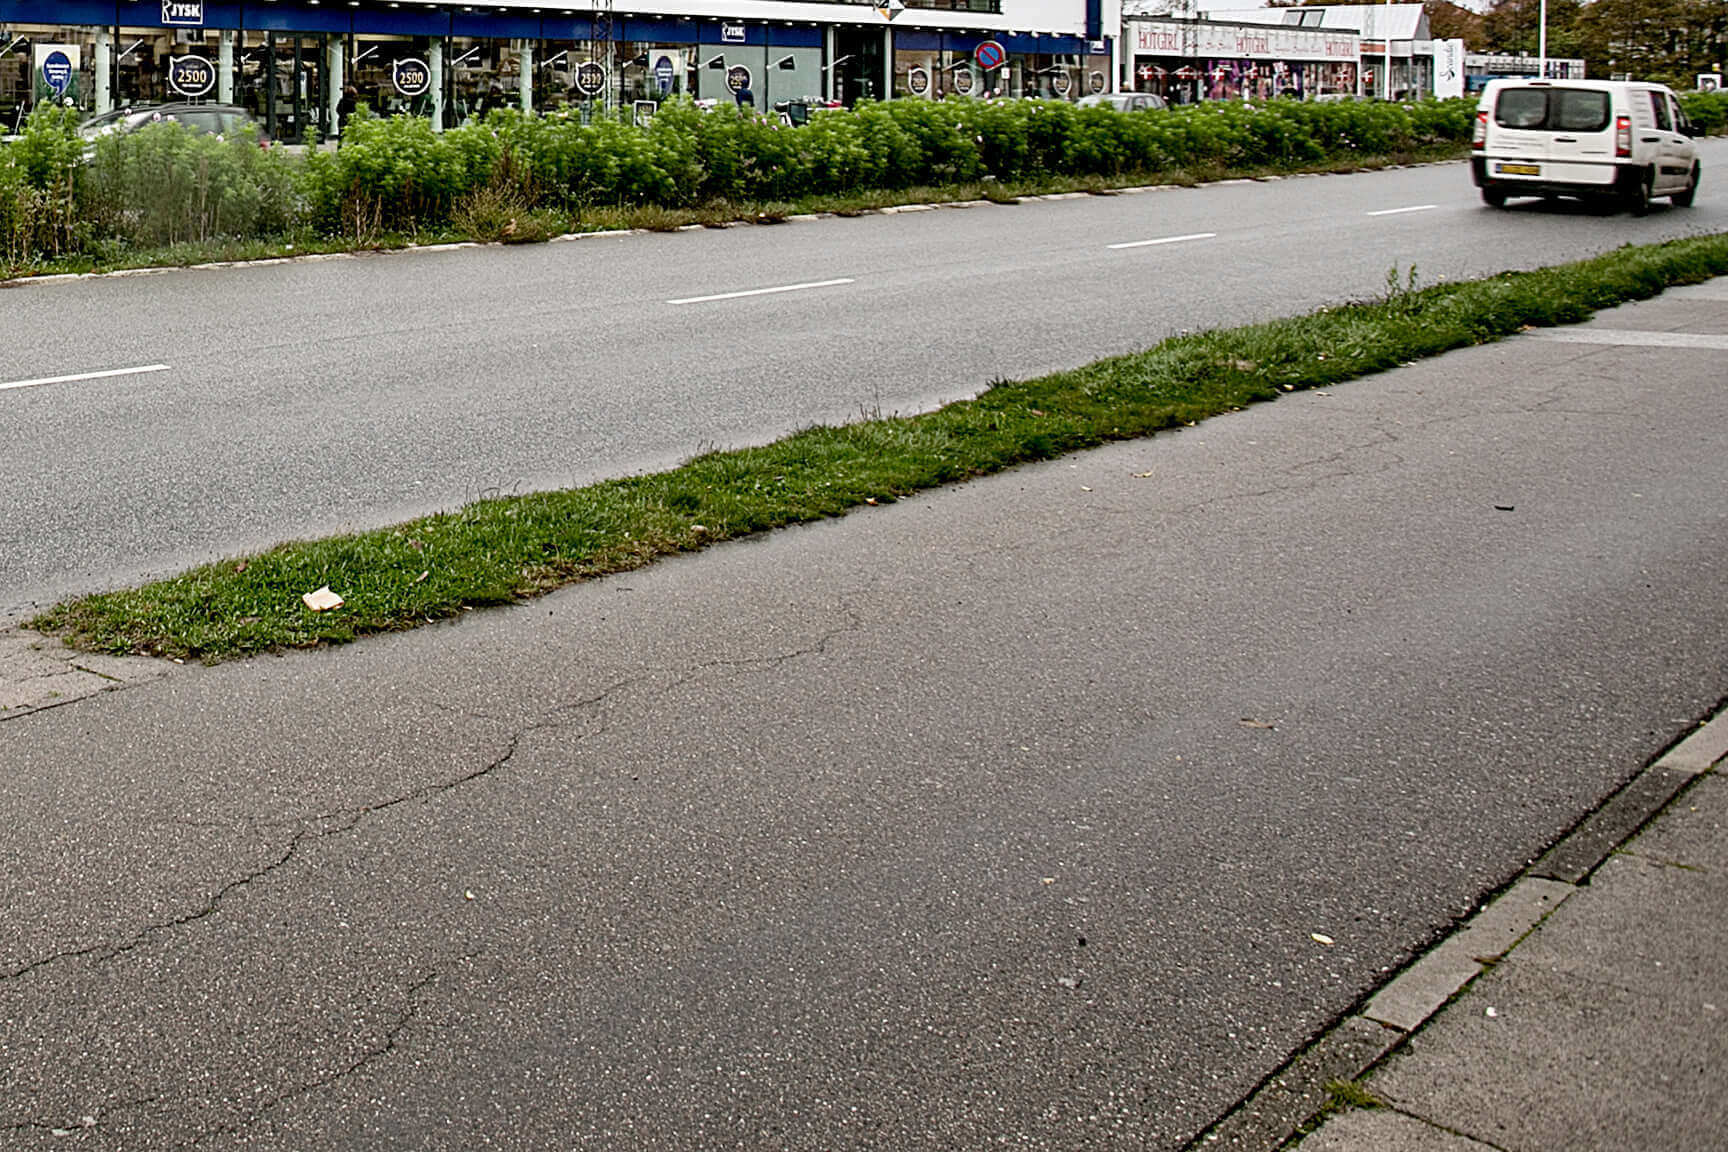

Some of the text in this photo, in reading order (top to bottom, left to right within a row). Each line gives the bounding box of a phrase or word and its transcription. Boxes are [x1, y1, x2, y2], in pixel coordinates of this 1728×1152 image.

[170, 3, 201, 17] JYSK
[177, 69, 207, 83] 2500
[399, 71, 424, 84] 2500
